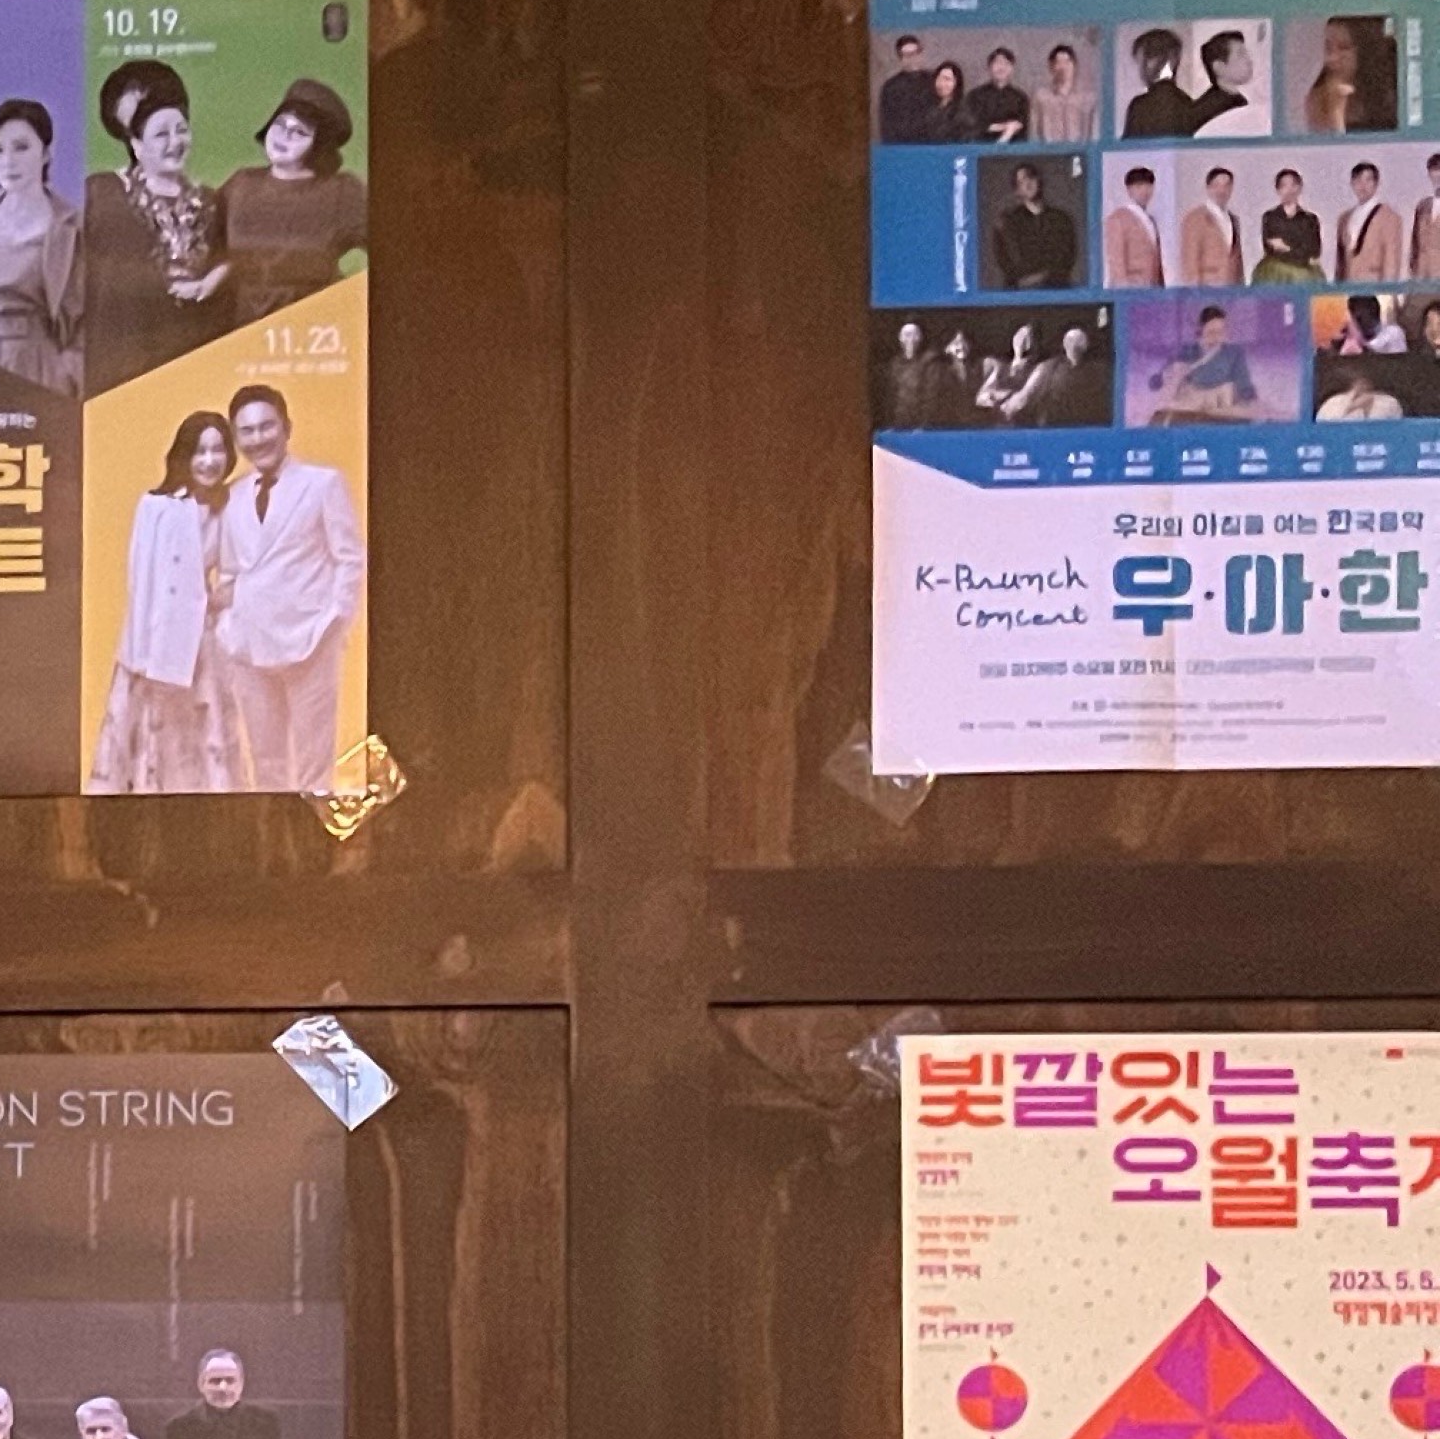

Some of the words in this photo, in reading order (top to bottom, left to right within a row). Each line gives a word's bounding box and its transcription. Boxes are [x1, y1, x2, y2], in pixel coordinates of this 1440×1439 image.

[1112, 513, 1183, 538] 우리의
[1274, 513, 1319, 535] 여는
[955, 602, 1089, 630] Concert
[916, 1050, 1300, 1128] 빛깔있는
[58, 1089, 235, 1127] STRING
